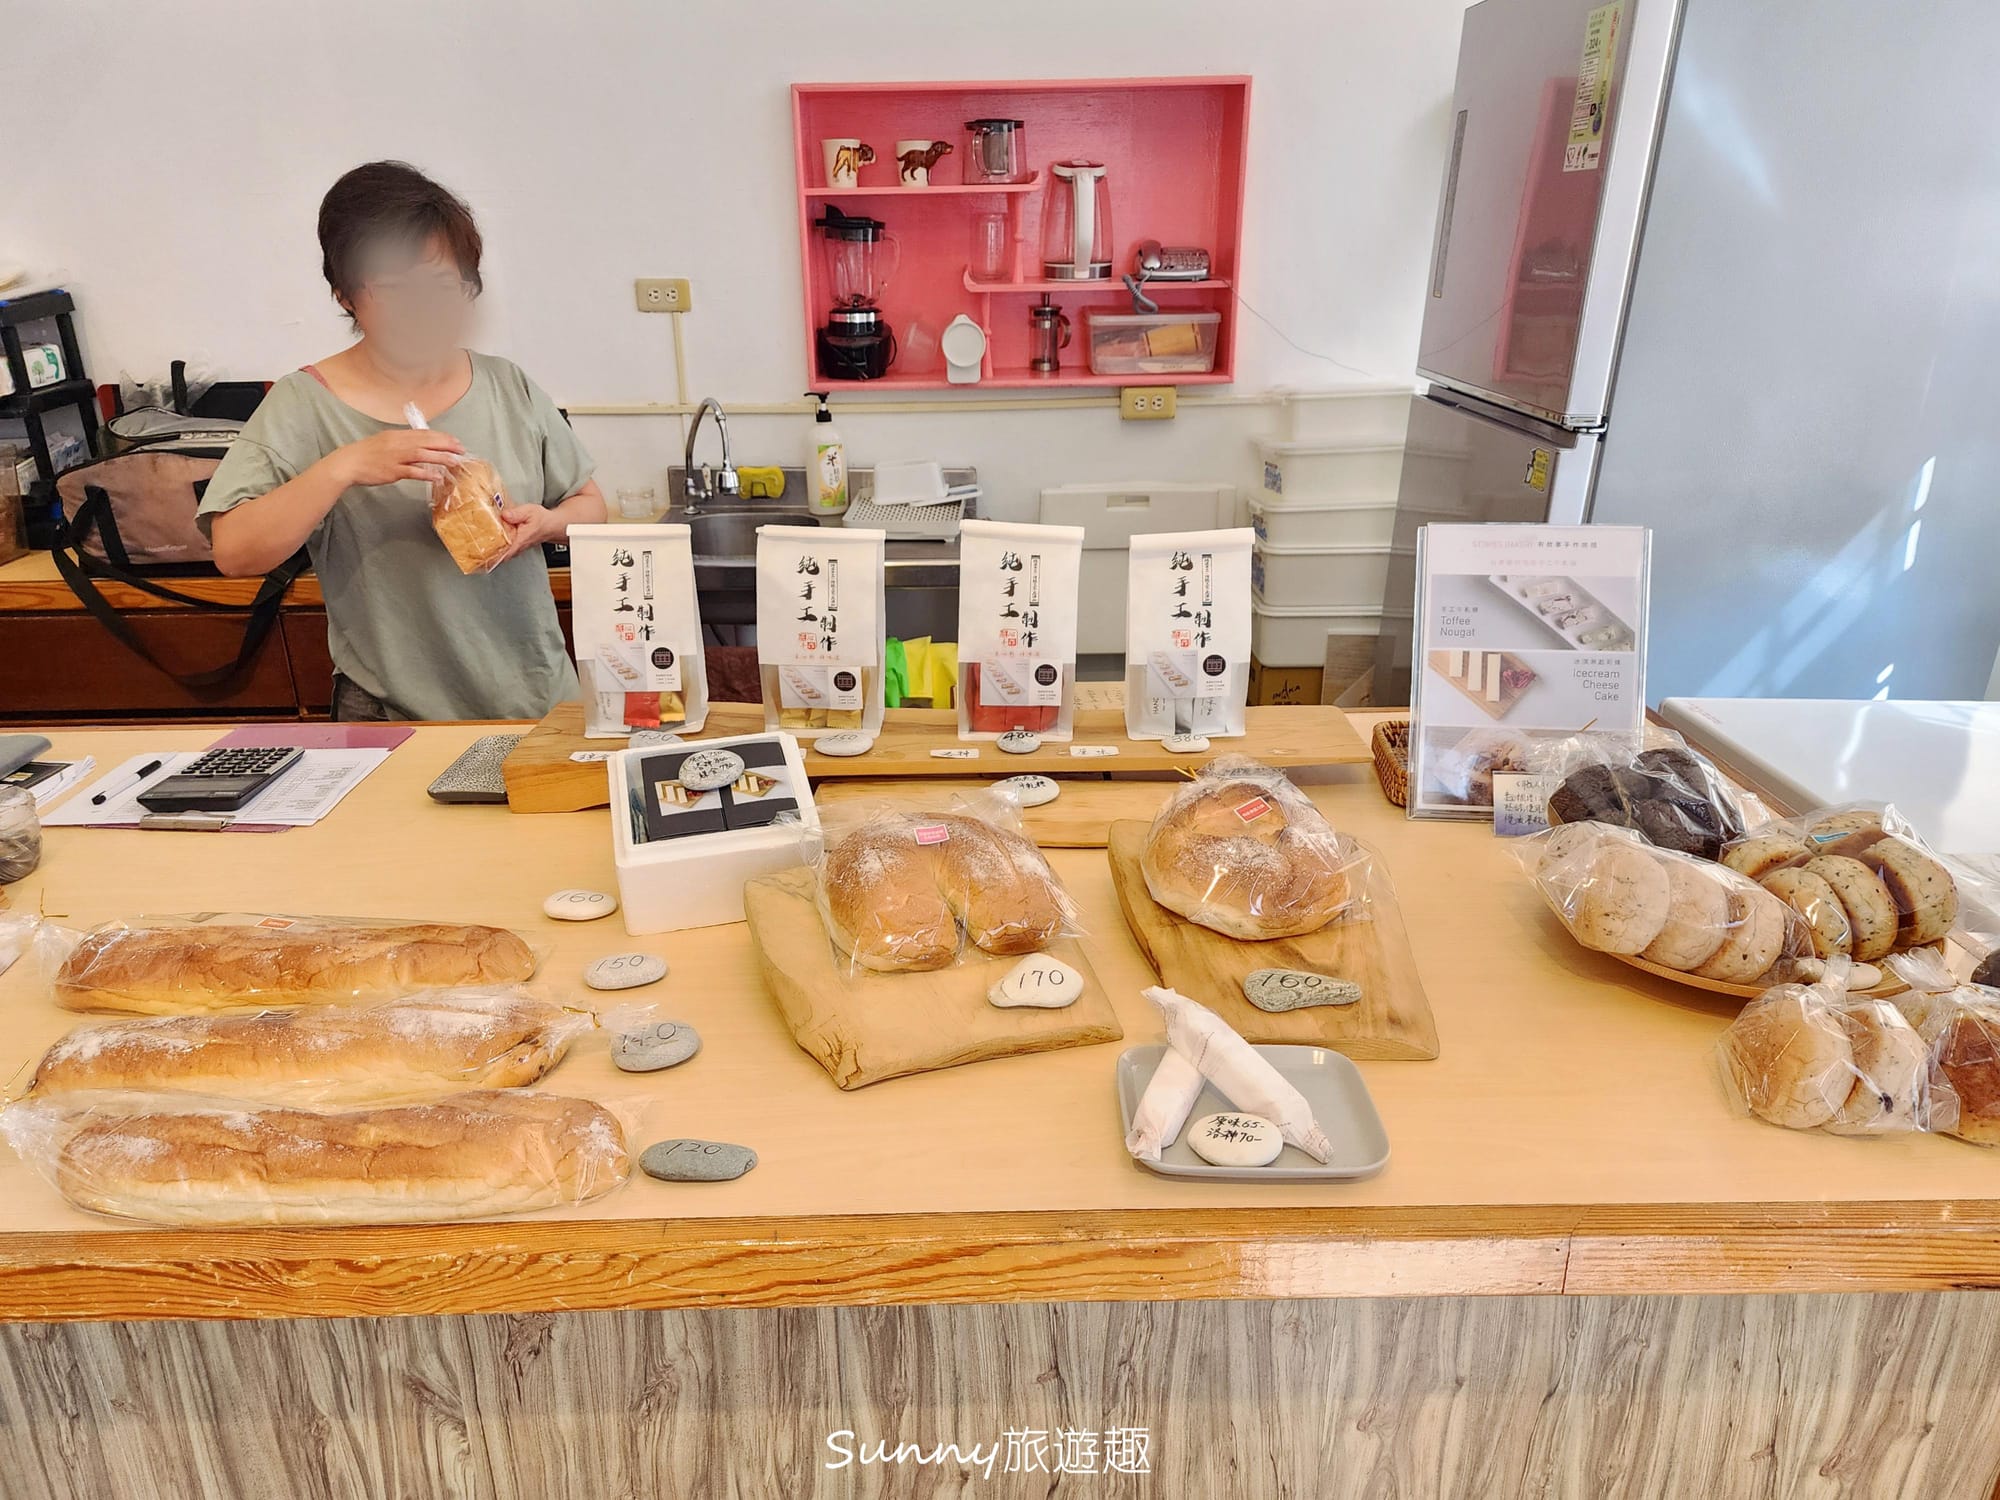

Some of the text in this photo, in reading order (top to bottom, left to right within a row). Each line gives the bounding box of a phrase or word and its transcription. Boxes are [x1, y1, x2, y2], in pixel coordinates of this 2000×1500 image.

[1440, 615, 1471, 626] Toffee
[1440, 627, 1475, 638] Nougat
[1573, 668, 1620, 678] Icecream
[1582, 679, 1620, 690] Cheese
[1594, 691, 1620, 701] Cake
[1002, 731, 1034, 741] 480
[556, 892, 605, 903] 160
[595, 955, 645, 972] 150
[1019, 969, 1065, 989] 170
[1261, 973, 1323, 989] 160
[621, 1022, 677, 1054] 140
[665, 1142, 722, 1156] 120
